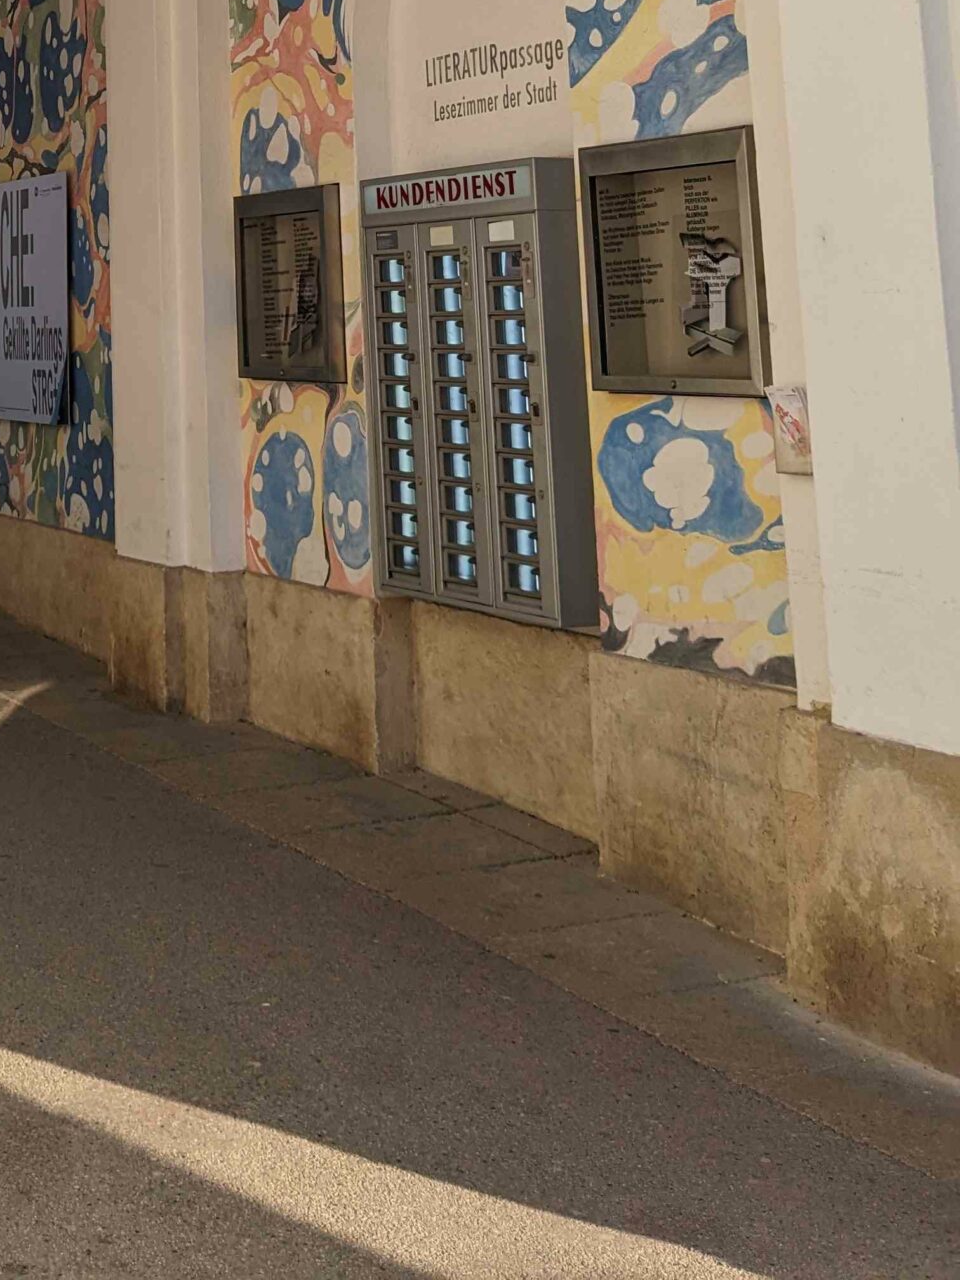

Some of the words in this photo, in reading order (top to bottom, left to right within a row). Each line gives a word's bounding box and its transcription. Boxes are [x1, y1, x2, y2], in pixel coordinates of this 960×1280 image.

[425, 39, 564, 88] LITERATURpassage
[434, 95, 499, 122] Lesezimmer
[502, 84, 521, 109] der
[525, 76, 557, 106] Stadt
[376, 170, 517, 210] KUNDENDIENST
[3, 315, 30, 361] Gekillte
